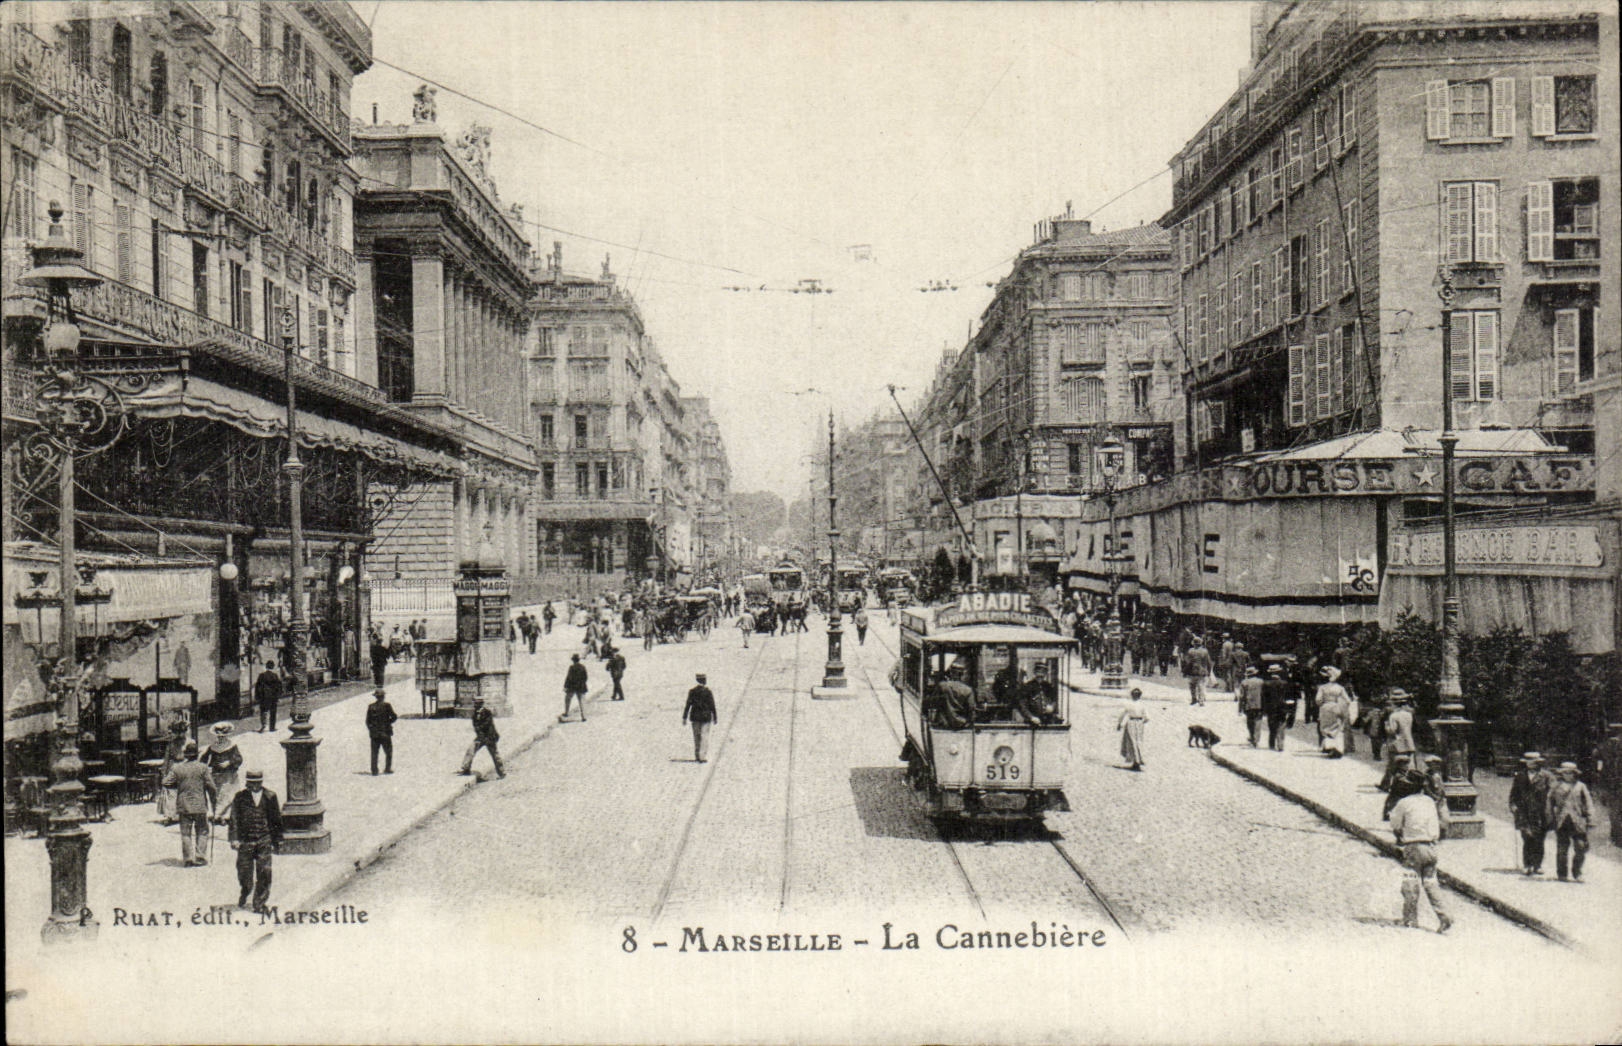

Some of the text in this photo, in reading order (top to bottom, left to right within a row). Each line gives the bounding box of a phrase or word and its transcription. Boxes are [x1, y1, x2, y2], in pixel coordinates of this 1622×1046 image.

[1246, 459, 1394, 495] OURSE
[1459, 457, 1595, 493] CAF
[1527, 529, 1583, 563] BAR
[959, 592, 1032, 612] ABADIE
[987, 765, 1020, 780] 519
